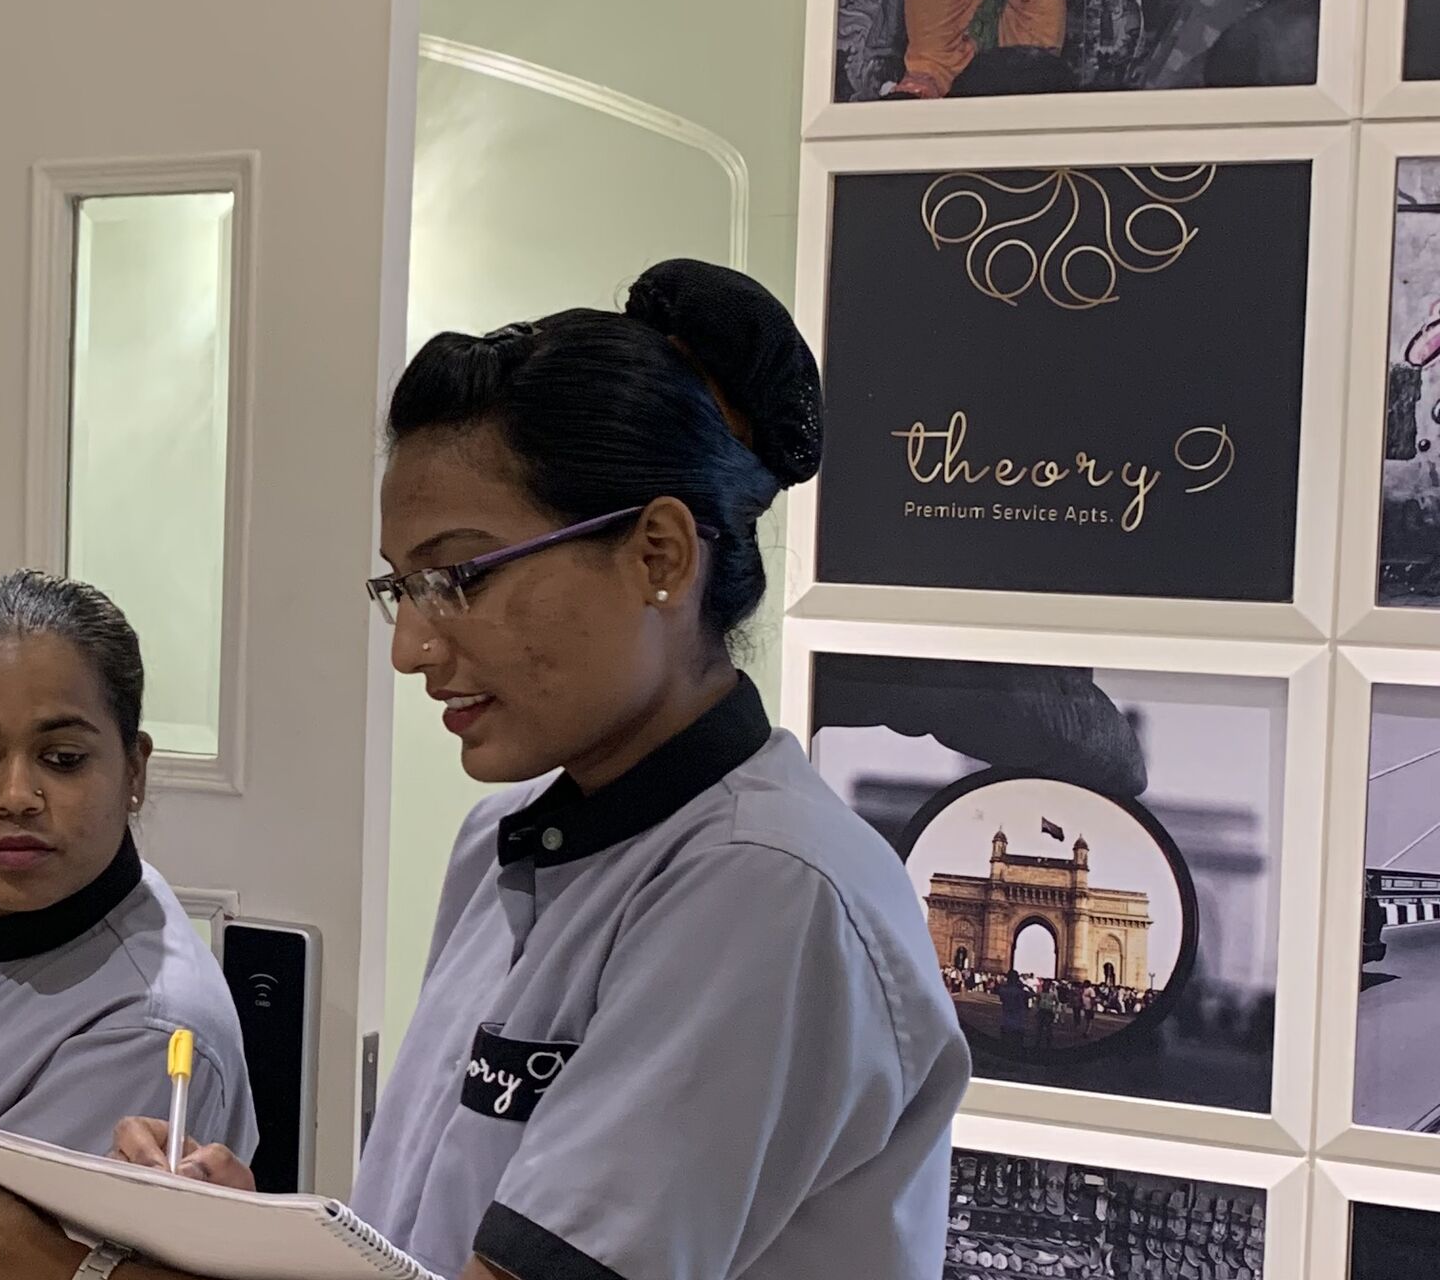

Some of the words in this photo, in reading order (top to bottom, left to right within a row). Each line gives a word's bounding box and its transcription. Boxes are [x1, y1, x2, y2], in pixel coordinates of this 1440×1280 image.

[891, 408, 1161, 532] theory
[1174, 424, 1235, 494] 9
[904, 501, 985, 520] Premium
[992, 503, 1058, 522] Service
[1064, 505, 1115, 525] Apts.
[466, 1057, 522, 1114] ory
